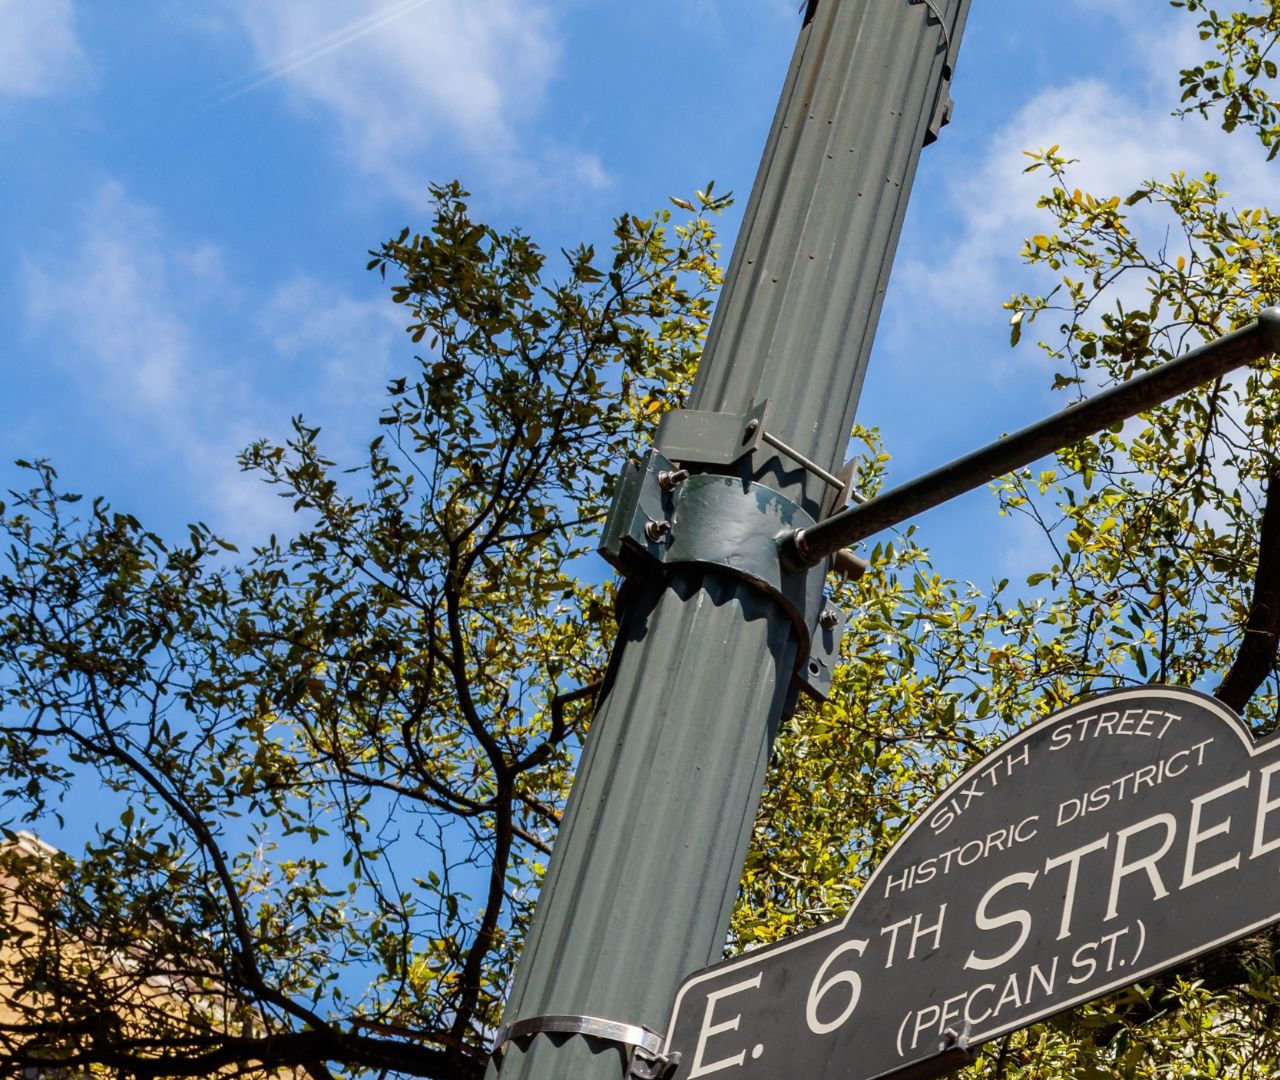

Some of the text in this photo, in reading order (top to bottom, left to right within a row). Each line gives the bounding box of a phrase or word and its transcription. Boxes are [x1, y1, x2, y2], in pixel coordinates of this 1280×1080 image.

[884, 736, 1214, 899] HISTORIC DISTRICT
[930, 708, 1183, 836] SIXTH STREET
[686, 971, 765, 1080] E.
[805, 902, 948, 1035] 6TH
[1067, 919, 1146, 985] ST.)
